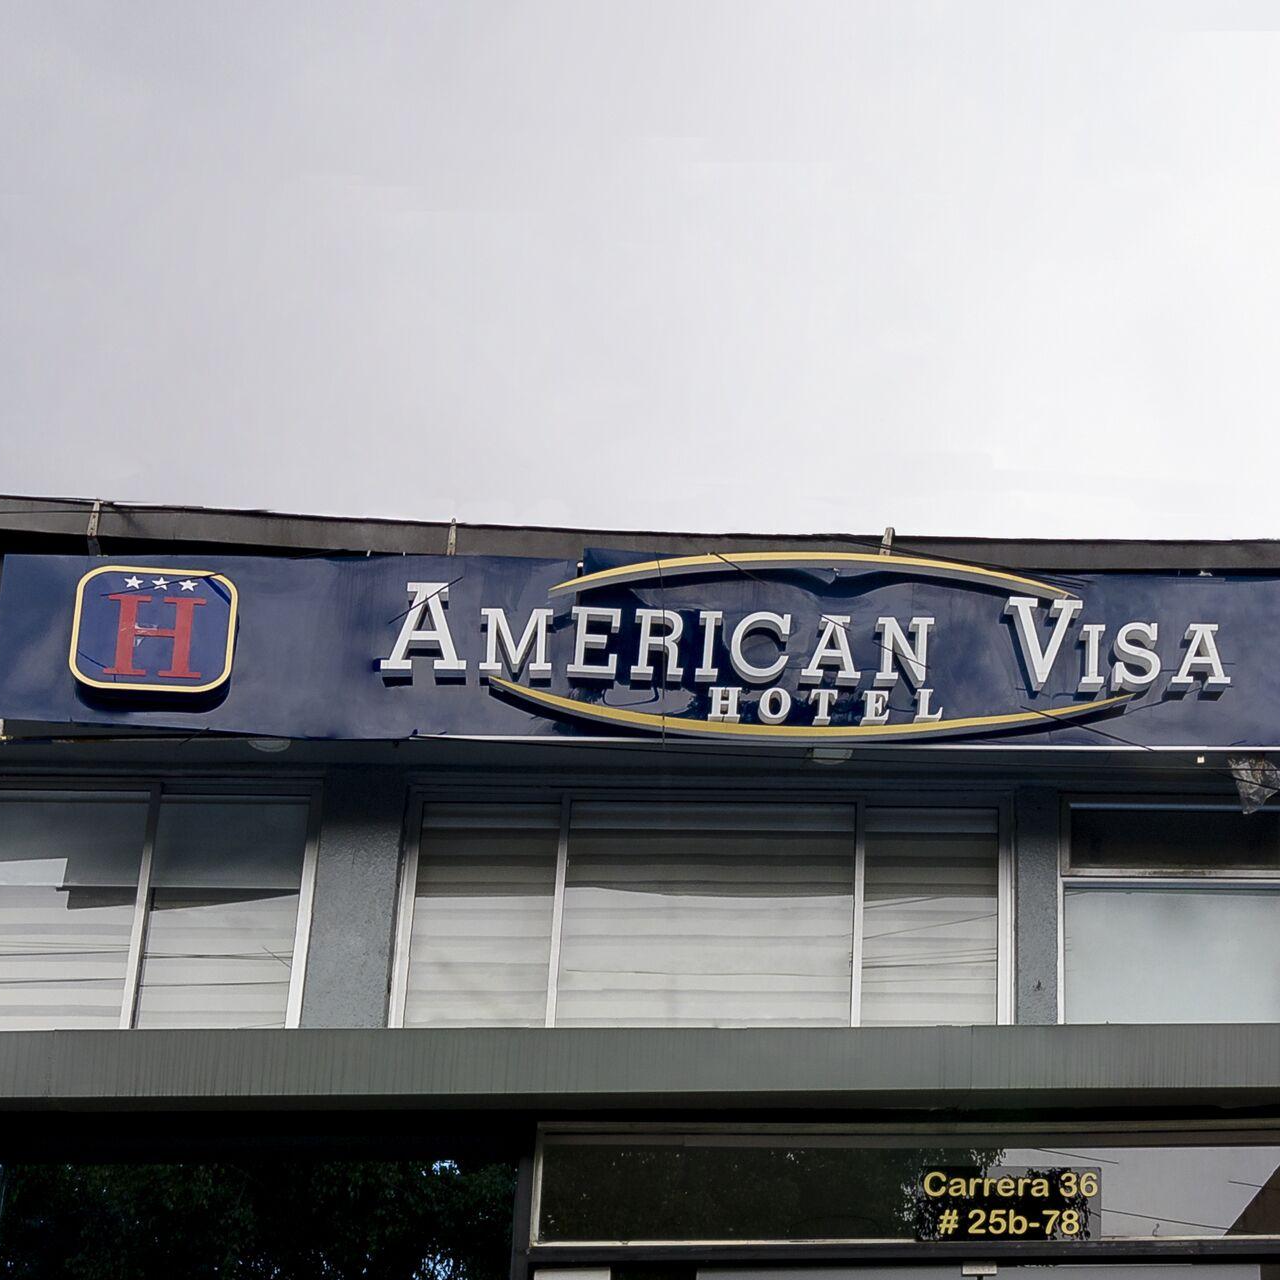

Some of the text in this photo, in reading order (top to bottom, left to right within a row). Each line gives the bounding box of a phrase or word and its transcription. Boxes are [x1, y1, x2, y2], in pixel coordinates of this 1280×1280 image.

[102, 593, 208, 680] H
[380, 581, 1233, 693] AMERICAN VISA
[708, 686, 944, 725] HOTEL
[923, 1171, 1099, 1198] Carrera 36
[938, 1208, 1080, 1235] # 25b-78
